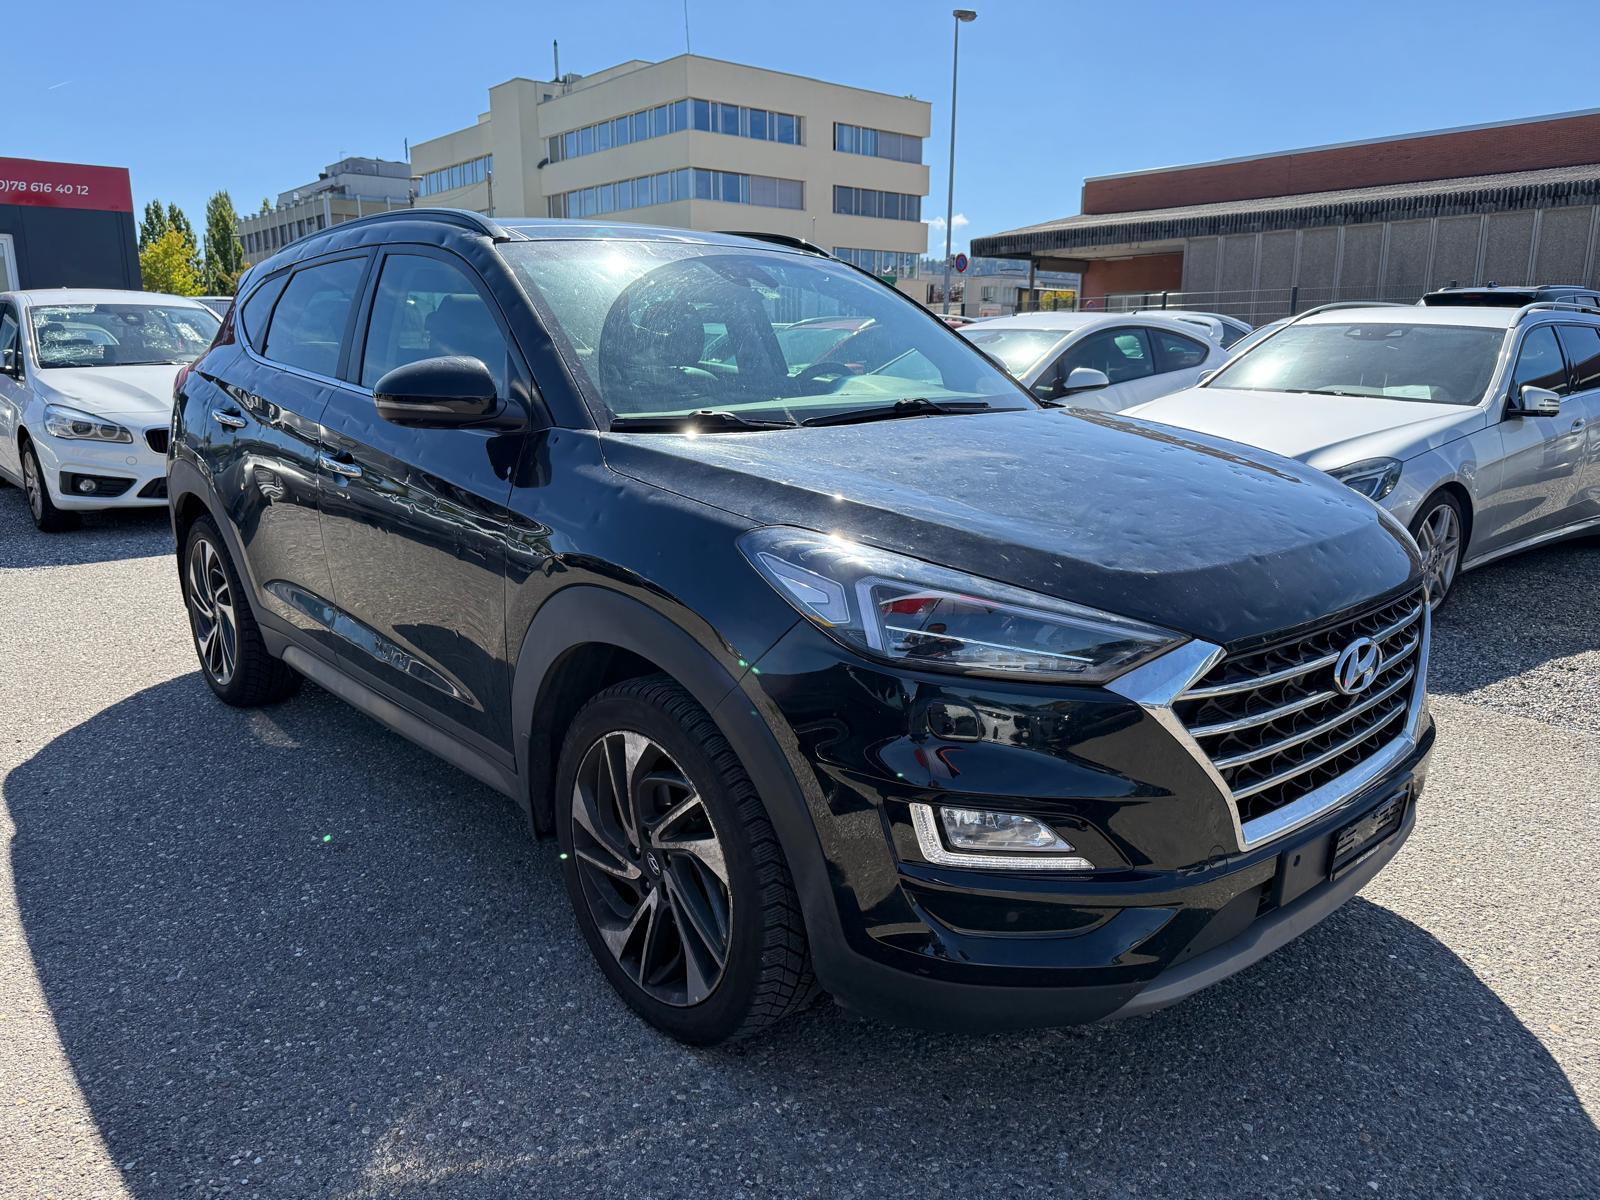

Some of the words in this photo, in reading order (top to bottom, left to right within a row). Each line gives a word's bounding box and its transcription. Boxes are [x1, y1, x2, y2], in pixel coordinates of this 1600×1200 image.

[31, 182, 52, 192] 616
[55, 184, 73, 194] 40
[76, 185, 89, 195] 12
